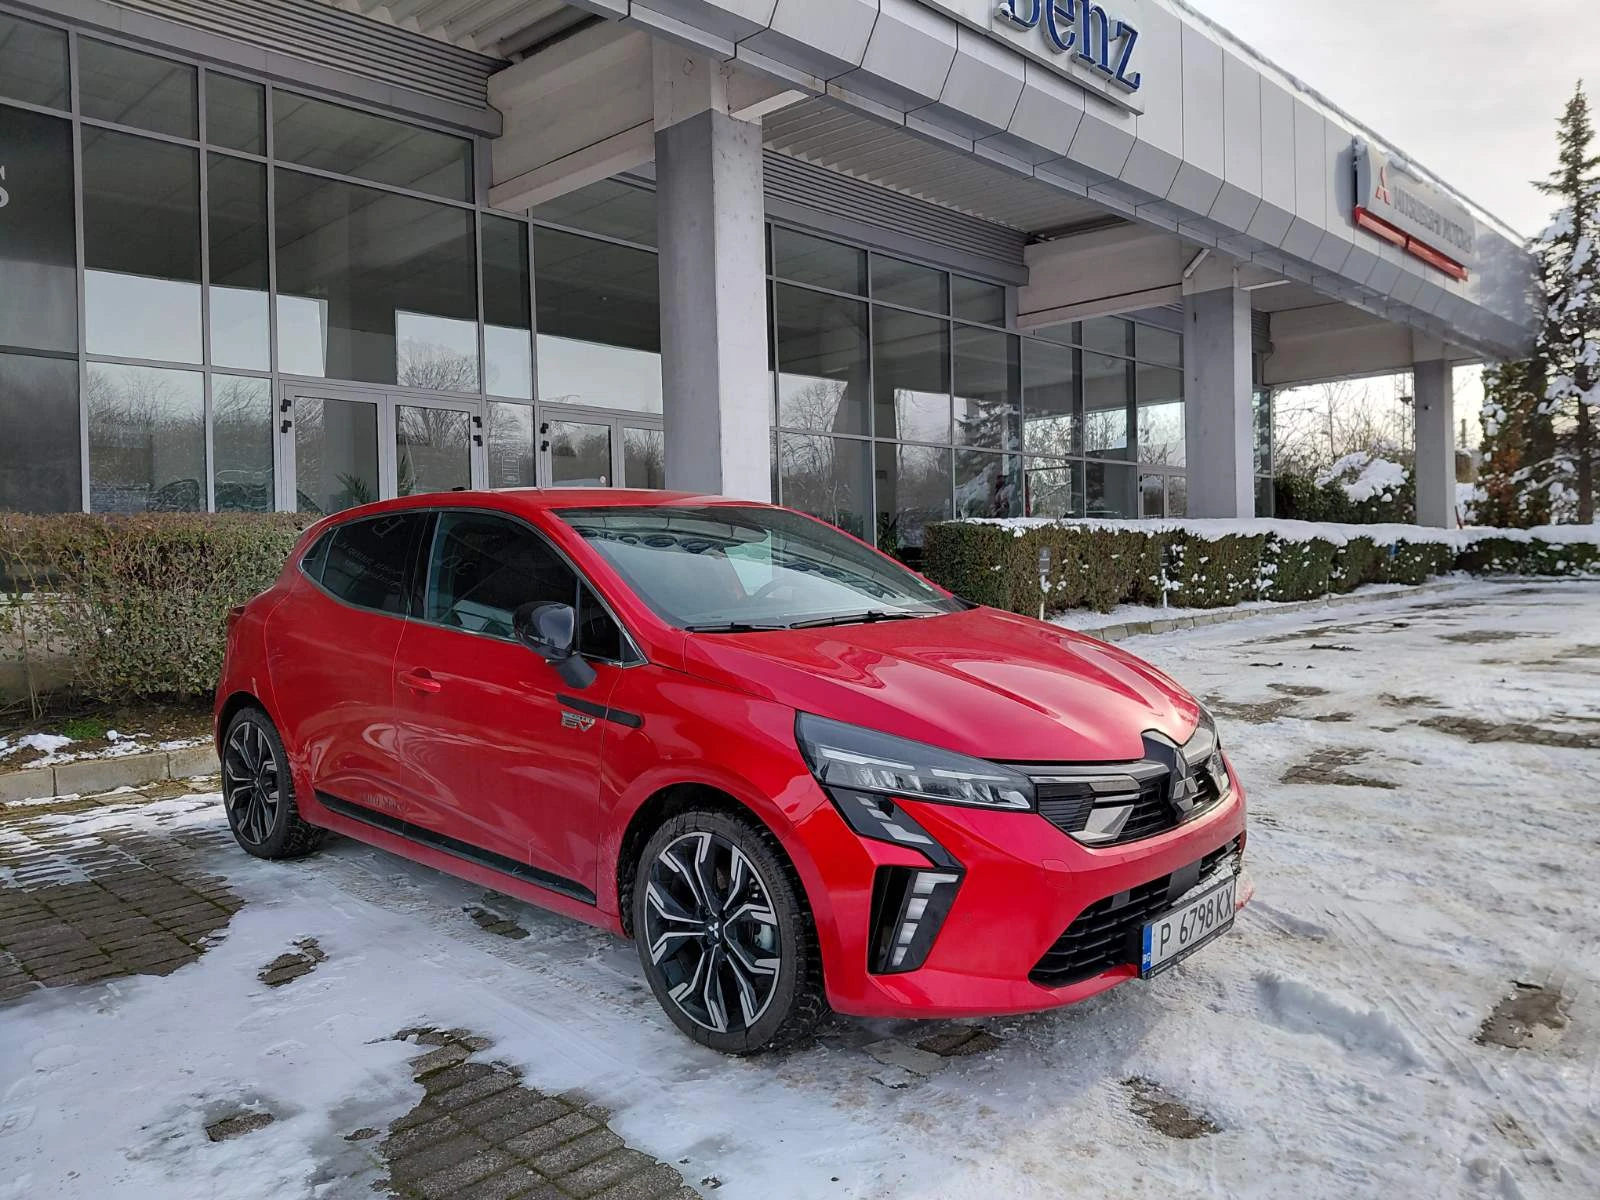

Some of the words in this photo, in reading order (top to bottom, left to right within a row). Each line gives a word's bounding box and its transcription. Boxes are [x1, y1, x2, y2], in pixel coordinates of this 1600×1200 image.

[1160, 922, 1171, 956] P
[1180, 898, 1213, 945] 6798
[1216, 885, 1232, 923] KX
